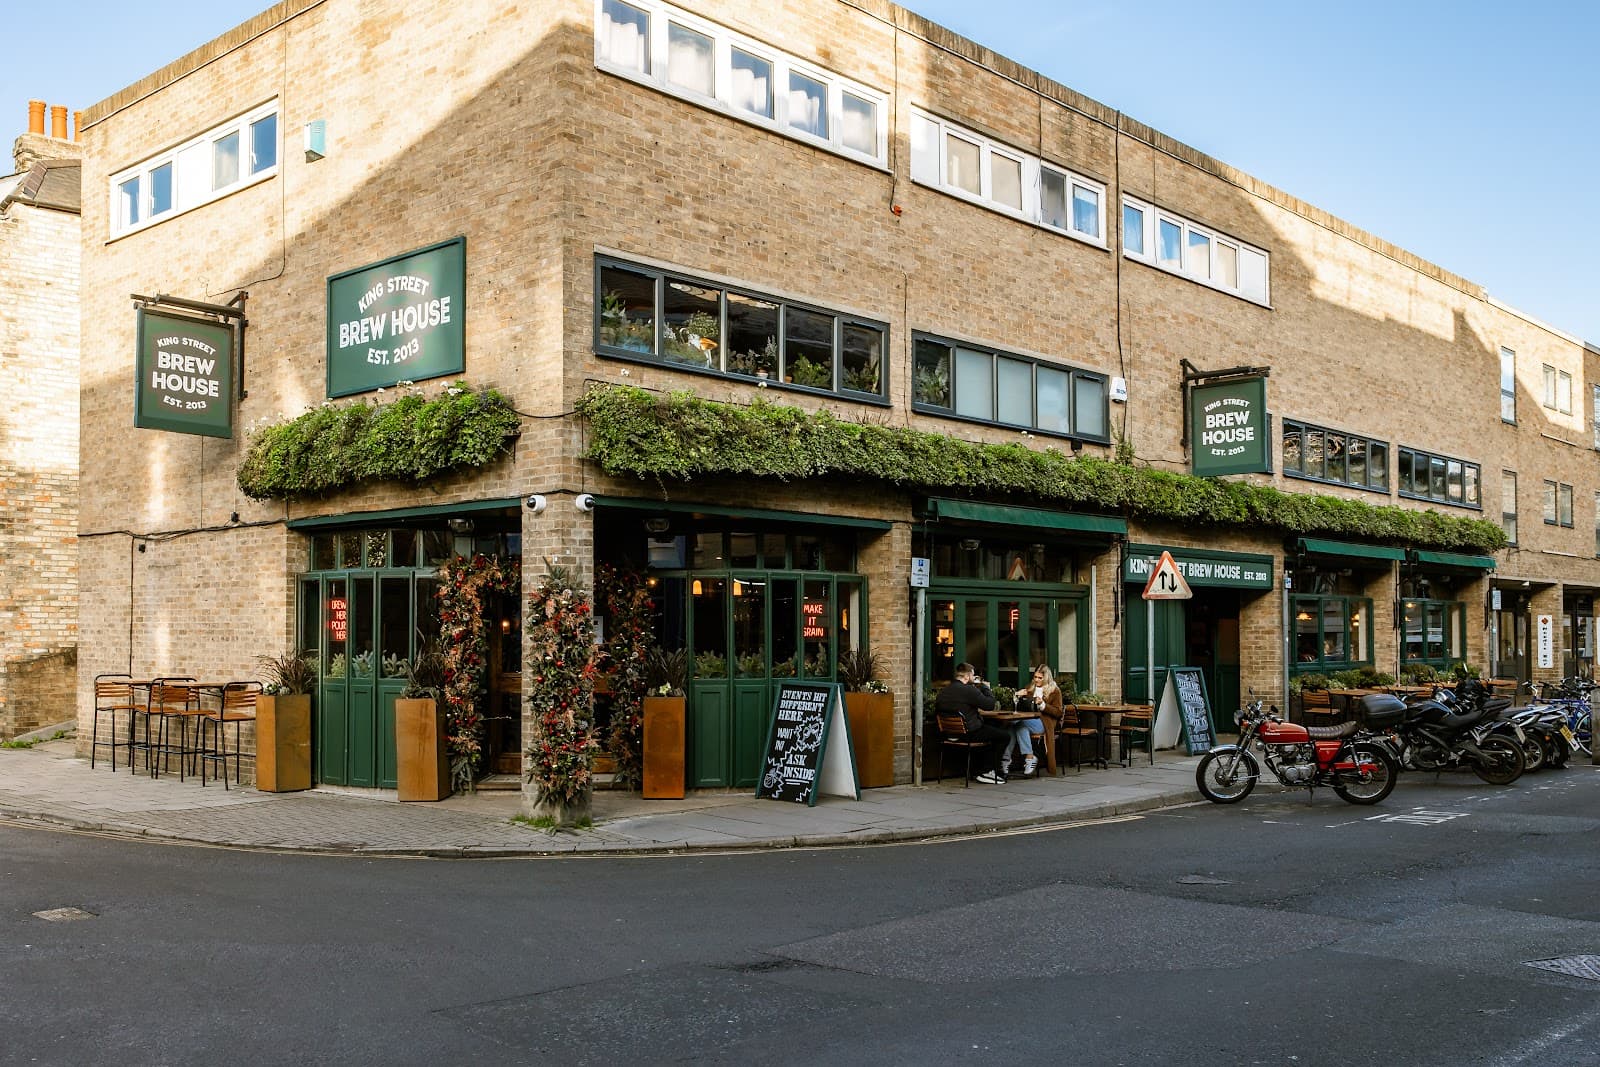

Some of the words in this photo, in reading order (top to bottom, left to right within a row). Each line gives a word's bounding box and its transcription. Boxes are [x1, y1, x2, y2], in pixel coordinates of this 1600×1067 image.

[358, 282, 384, 314] KING
[387, 275, 429, 296] STREET
[339, 313, 386, 348] BREW
[391, 296, 451, 336] HOUSE
[157, 337, 179, 347] KING
[182, 337, 216, 356] STREET
[367, 348, 390, 365] EST.
[393, 338, 419, 363] 2013
[158, 351, 216, 375] BREW
[152, 371, 219, 397] HOUSE
[163, 395, 183, 408] EST.
[185, 400, 207, 409] 2013
[1204, 400, 1222, 413] KING
[1222, 398, 1250, 408] STREET
[1205, 410, 1250, 429] BREW
[1202, 426, 1255, 446] HOUSE
[1211, 448, 1226, 456] EST.
[1228, 446, 1245, 456] 2013
[1129, 558, 1148, 574] KIN
[1188, 562, 1213, 579] BREW
[1214, 564, 1241, 580] HOUSE
[1255, 572, 1267, 581] 2013
[803, 604, 823, 614] MAKE
[808, 616, 817, 626] IT
[782, 689, 813, 702] EVENTS
[813, 692, 828, 703] HIT
[780, 700, 825, 713] DIFFERENT
[777, 709, 804, 722] HERE
[777, 727, 794, 740] WANT
[786, 753, 807, 766] ASK
[783, 766, 815, 781] INSIDE
